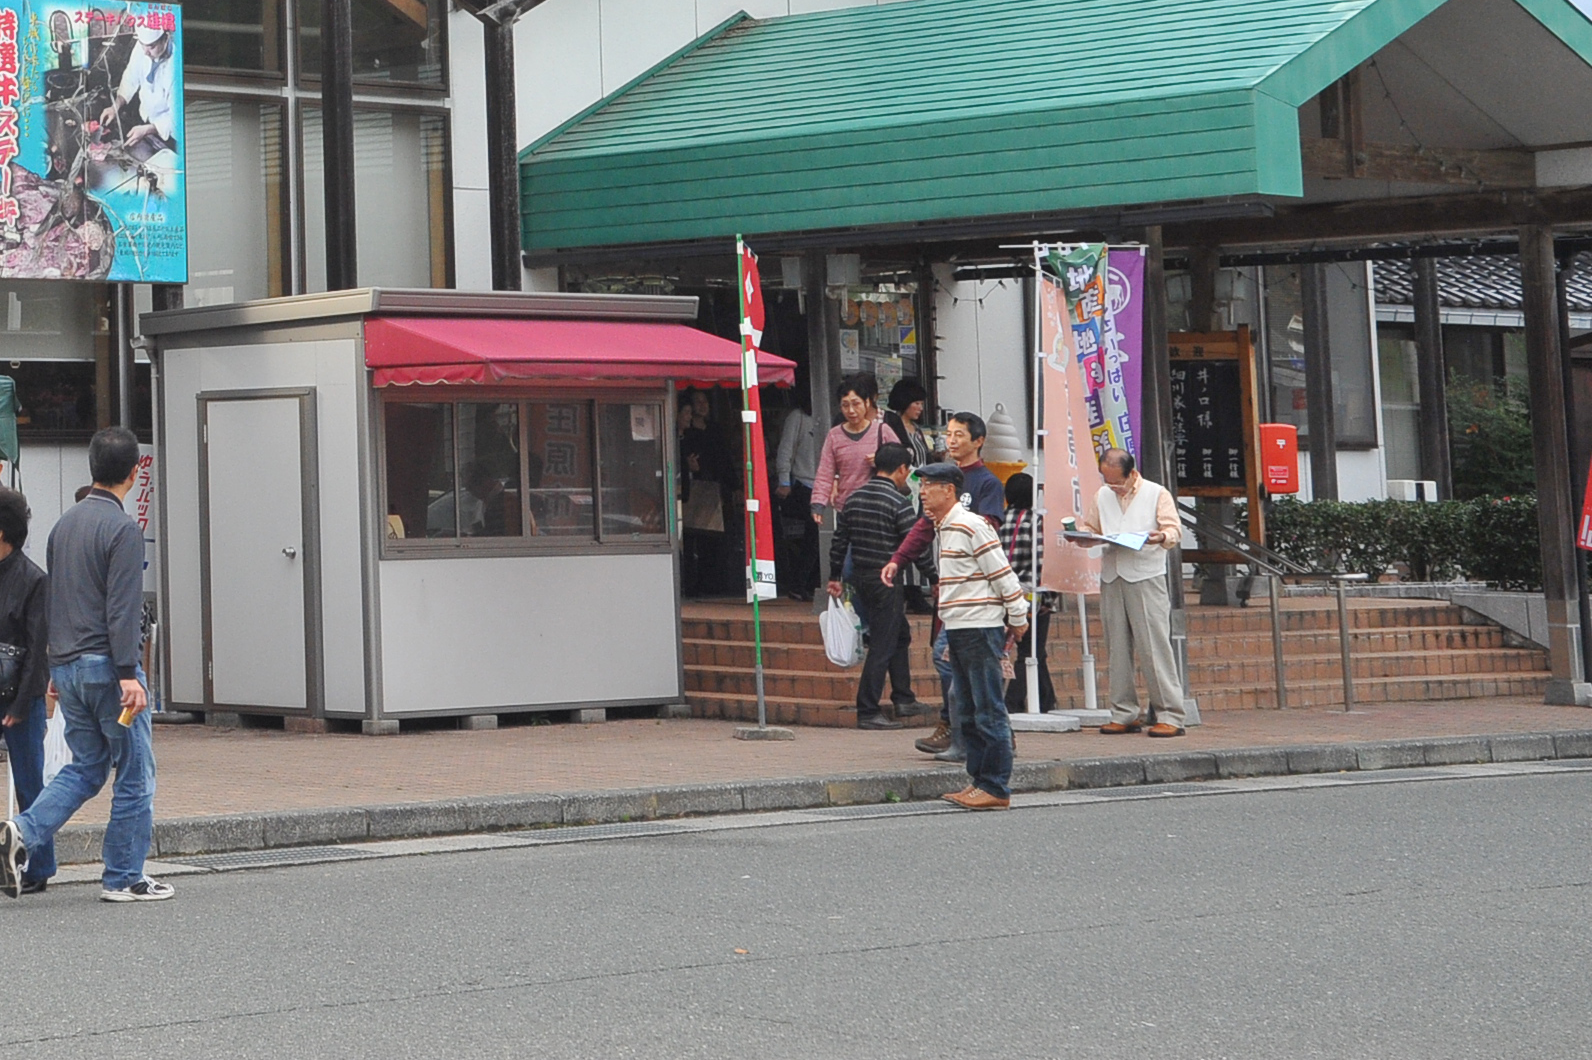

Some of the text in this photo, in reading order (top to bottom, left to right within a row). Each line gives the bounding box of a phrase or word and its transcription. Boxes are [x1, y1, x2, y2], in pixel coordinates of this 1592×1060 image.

[136, 454, 154, 533] ゆうパック
